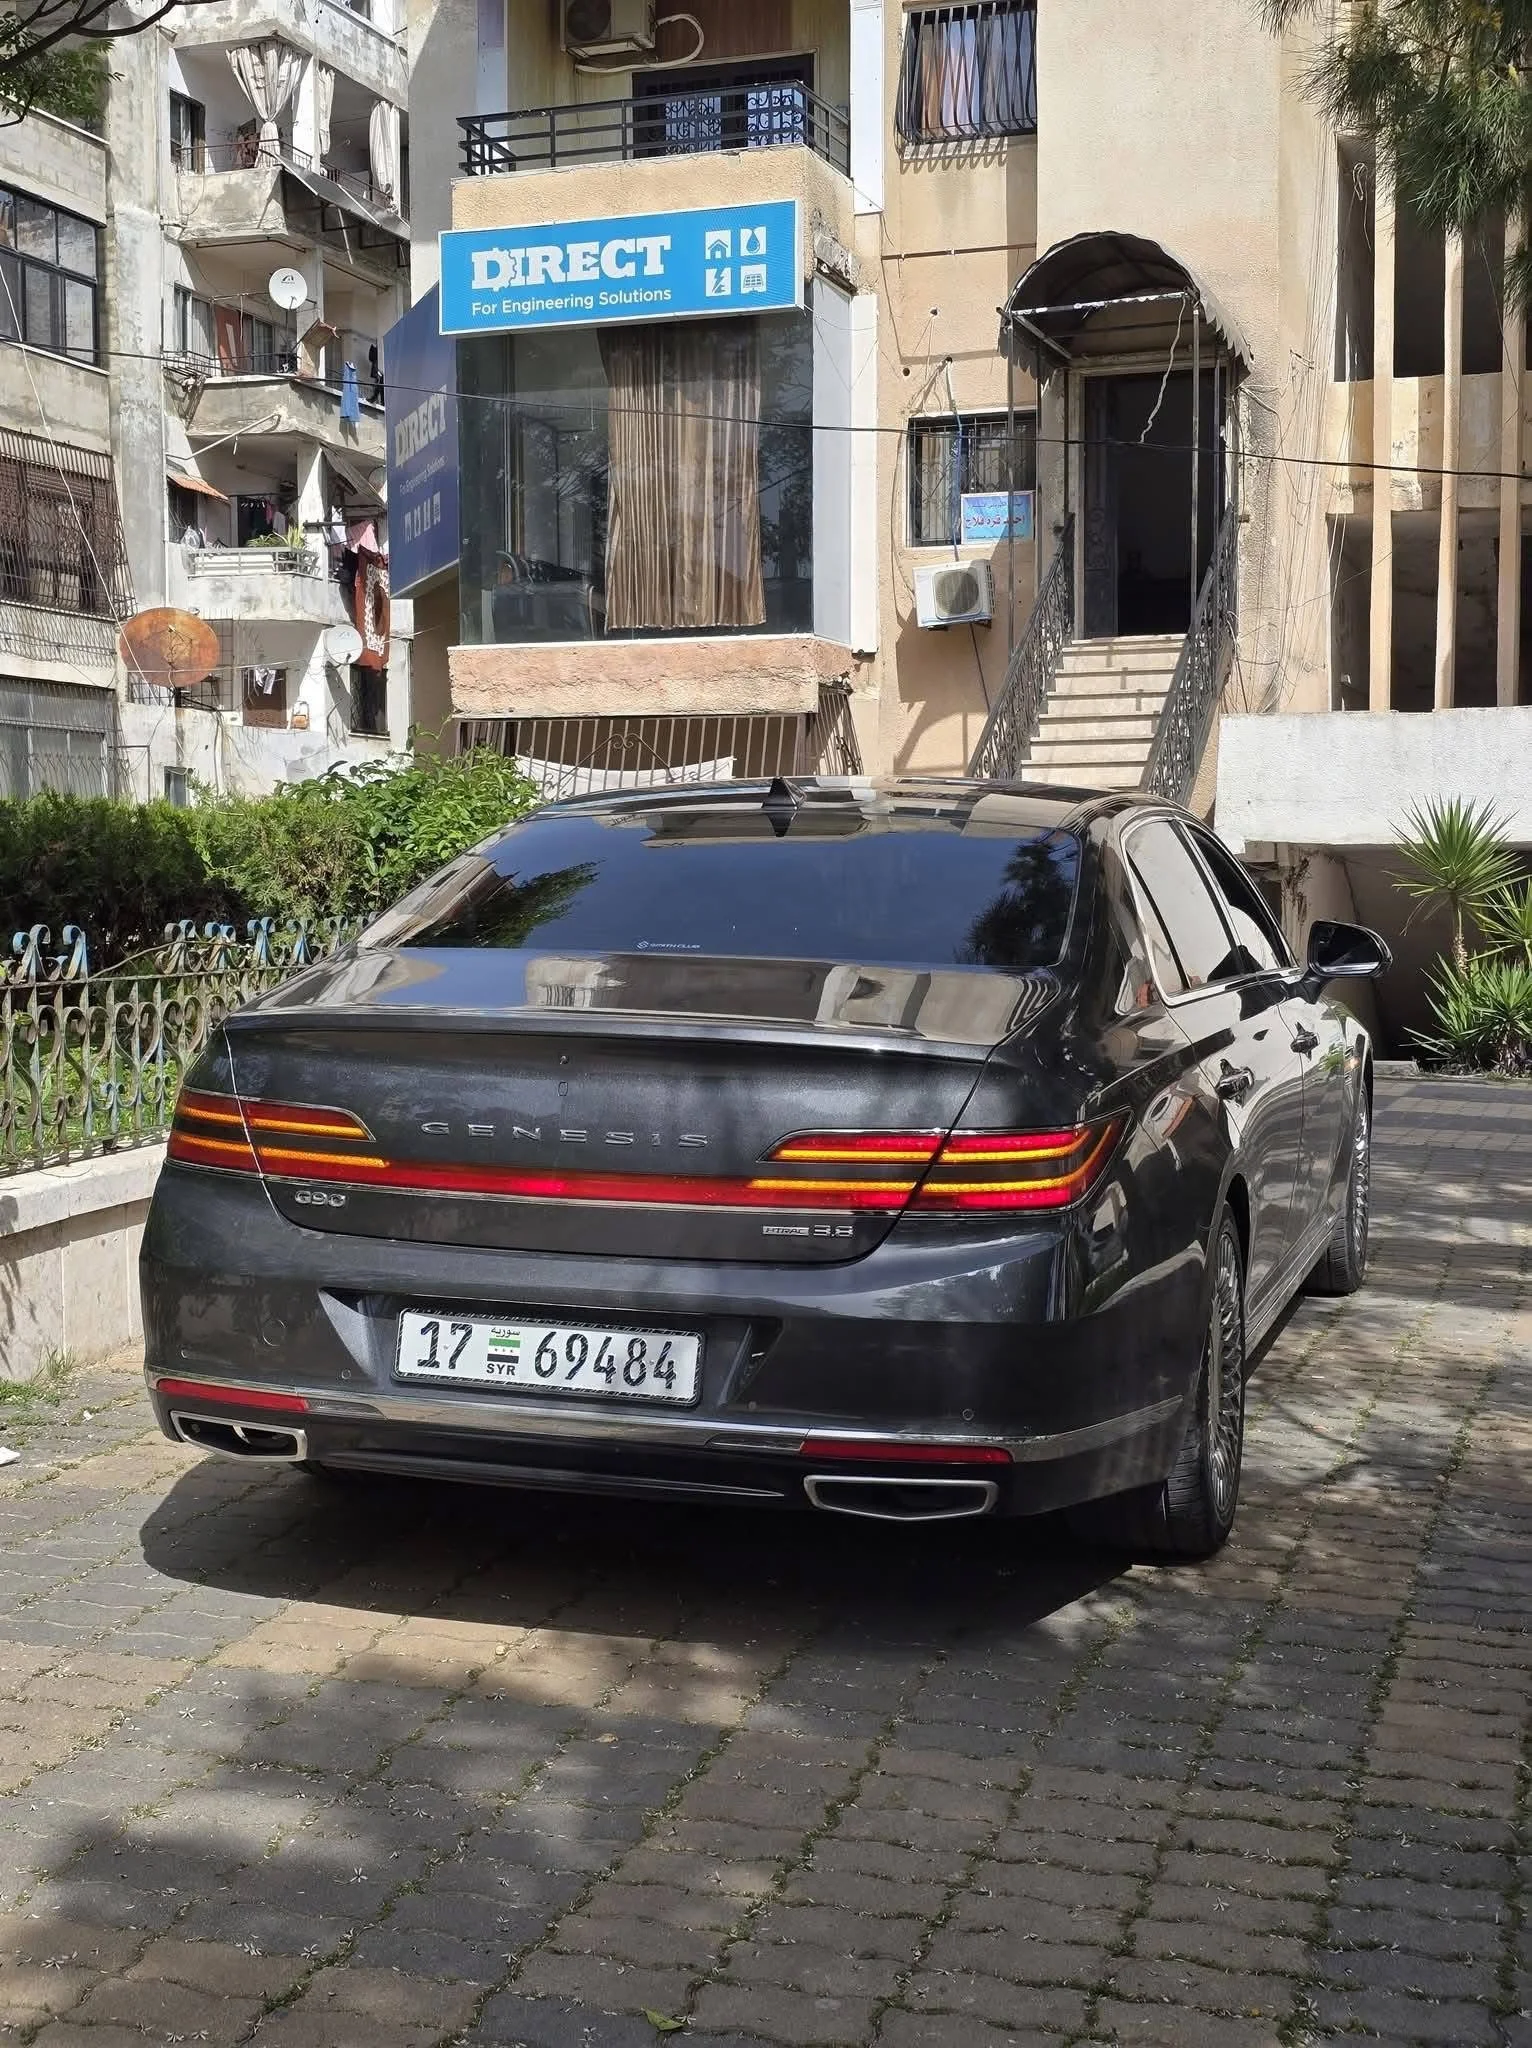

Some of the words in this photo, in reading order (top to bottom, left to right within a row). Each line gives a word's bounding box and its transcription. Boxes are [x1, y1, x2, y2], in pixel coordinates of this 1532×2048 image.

[471, 235, 672, 292] DIRECT
[472, 301, 497, 316] For
[502, 294, 595, 315] Engineering
[599, 288, 672, 306] Solutions
[394, 384, 447, 468] DIRECT
[1003, 514, 1025, 525] احد
[420, 1121, 708, 1148] GENESIS
[294, 1190, 348, 1208] G90
[764, 1226, 808, 1236] HTRAC
[416, 1321, 473, 1370] 17
[534, 1331, 677, 1390] 69484
[486, 1363, 516, 1376] SYR
